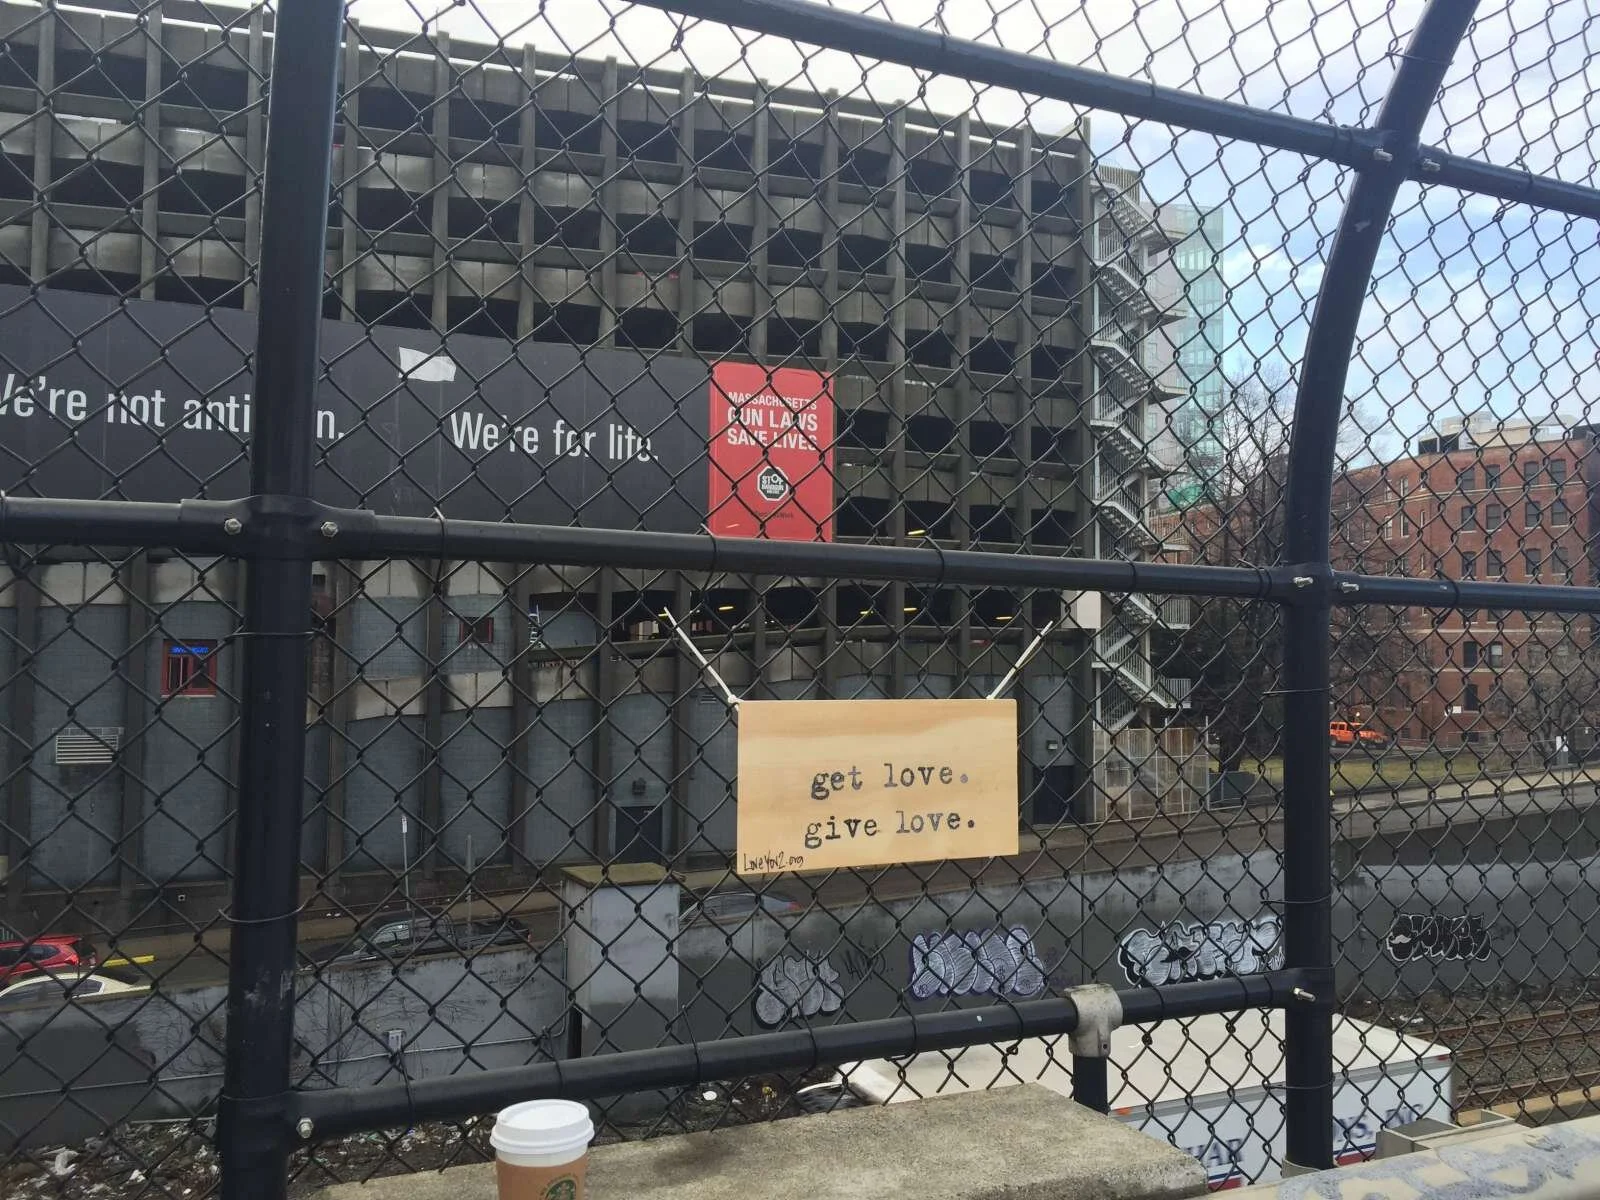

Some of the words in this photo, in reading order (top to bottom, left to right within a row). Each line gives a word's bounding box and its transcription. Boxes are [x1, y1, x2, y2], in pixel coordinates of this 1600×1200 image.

[107, 389, 166, 427] not
[450, 411, 539, 454] We're
[552, 419, 597, 457] for
[608, 423, 659, 462] life.
[727, 406, 763, 427] GUN
[768, 410, 818, 432] LAWS
[727, 427, 768, 446] SAVE
[773, 431, 817, 451] LIVES
[810, 765, 864, 801] get
[883, 762, 969, 789] love.
[804, 815, 878, 849] give
[895, 810, 975, 834] love.
